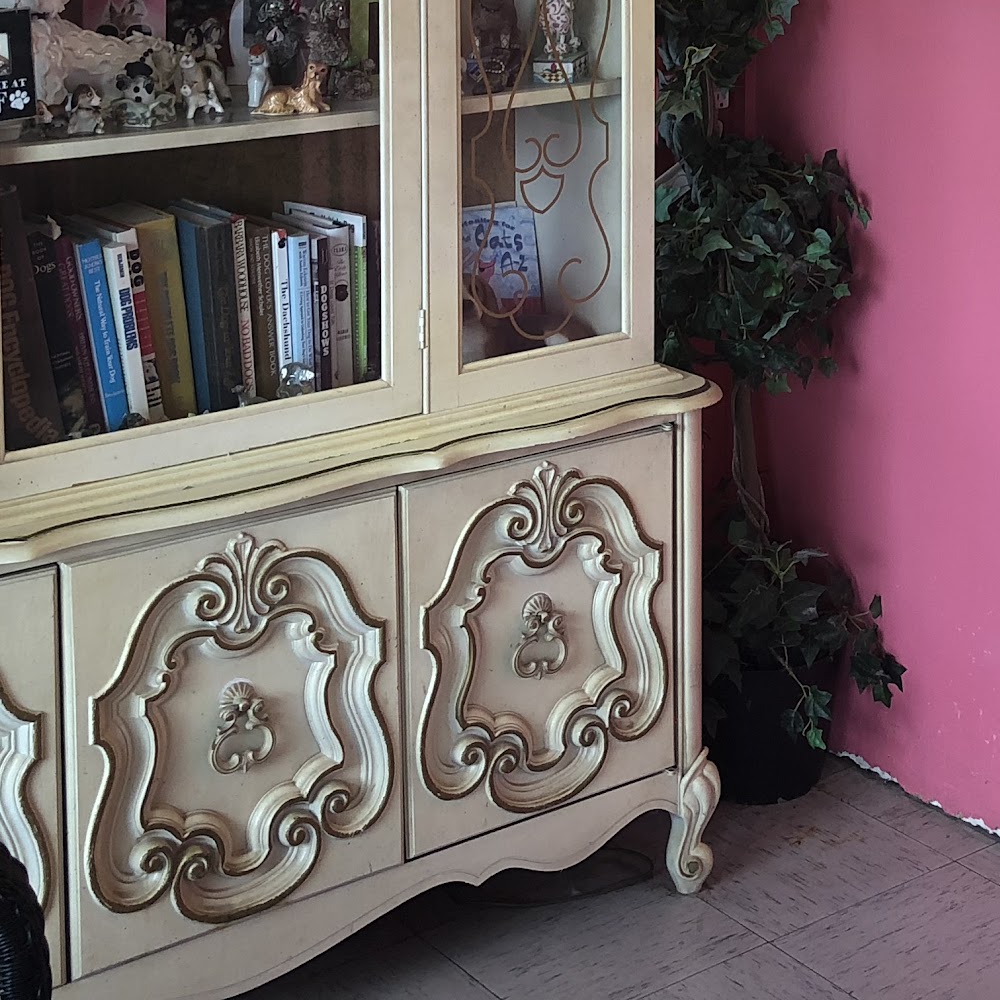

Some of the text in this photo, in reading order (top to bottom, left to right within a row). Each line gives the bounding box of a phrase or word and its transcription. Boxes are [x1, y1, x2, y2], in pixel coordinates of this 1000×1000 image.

[261, 235, 269, 250] THE
[129, 248, 144, 288] DOG
[263, 253, 272, 274] DOG
[96, 293, 105, 317] Natural
[119, 287, 133, 307] DOG
[233, 220, 254, 391] BARBARA WOODHOUSE NO BAD DOGS
[99, 316, 108, 330] Way
[121, 305, 138, 351] PROBLEMS
[266, 313, 275, 347] ANSWER
[281, 280, 292, 361] The Dachshund
[103, 338, 112, 355] Train
[269, 350, 277, 376] BOOK
[109, 369, 117, 384] Dog
